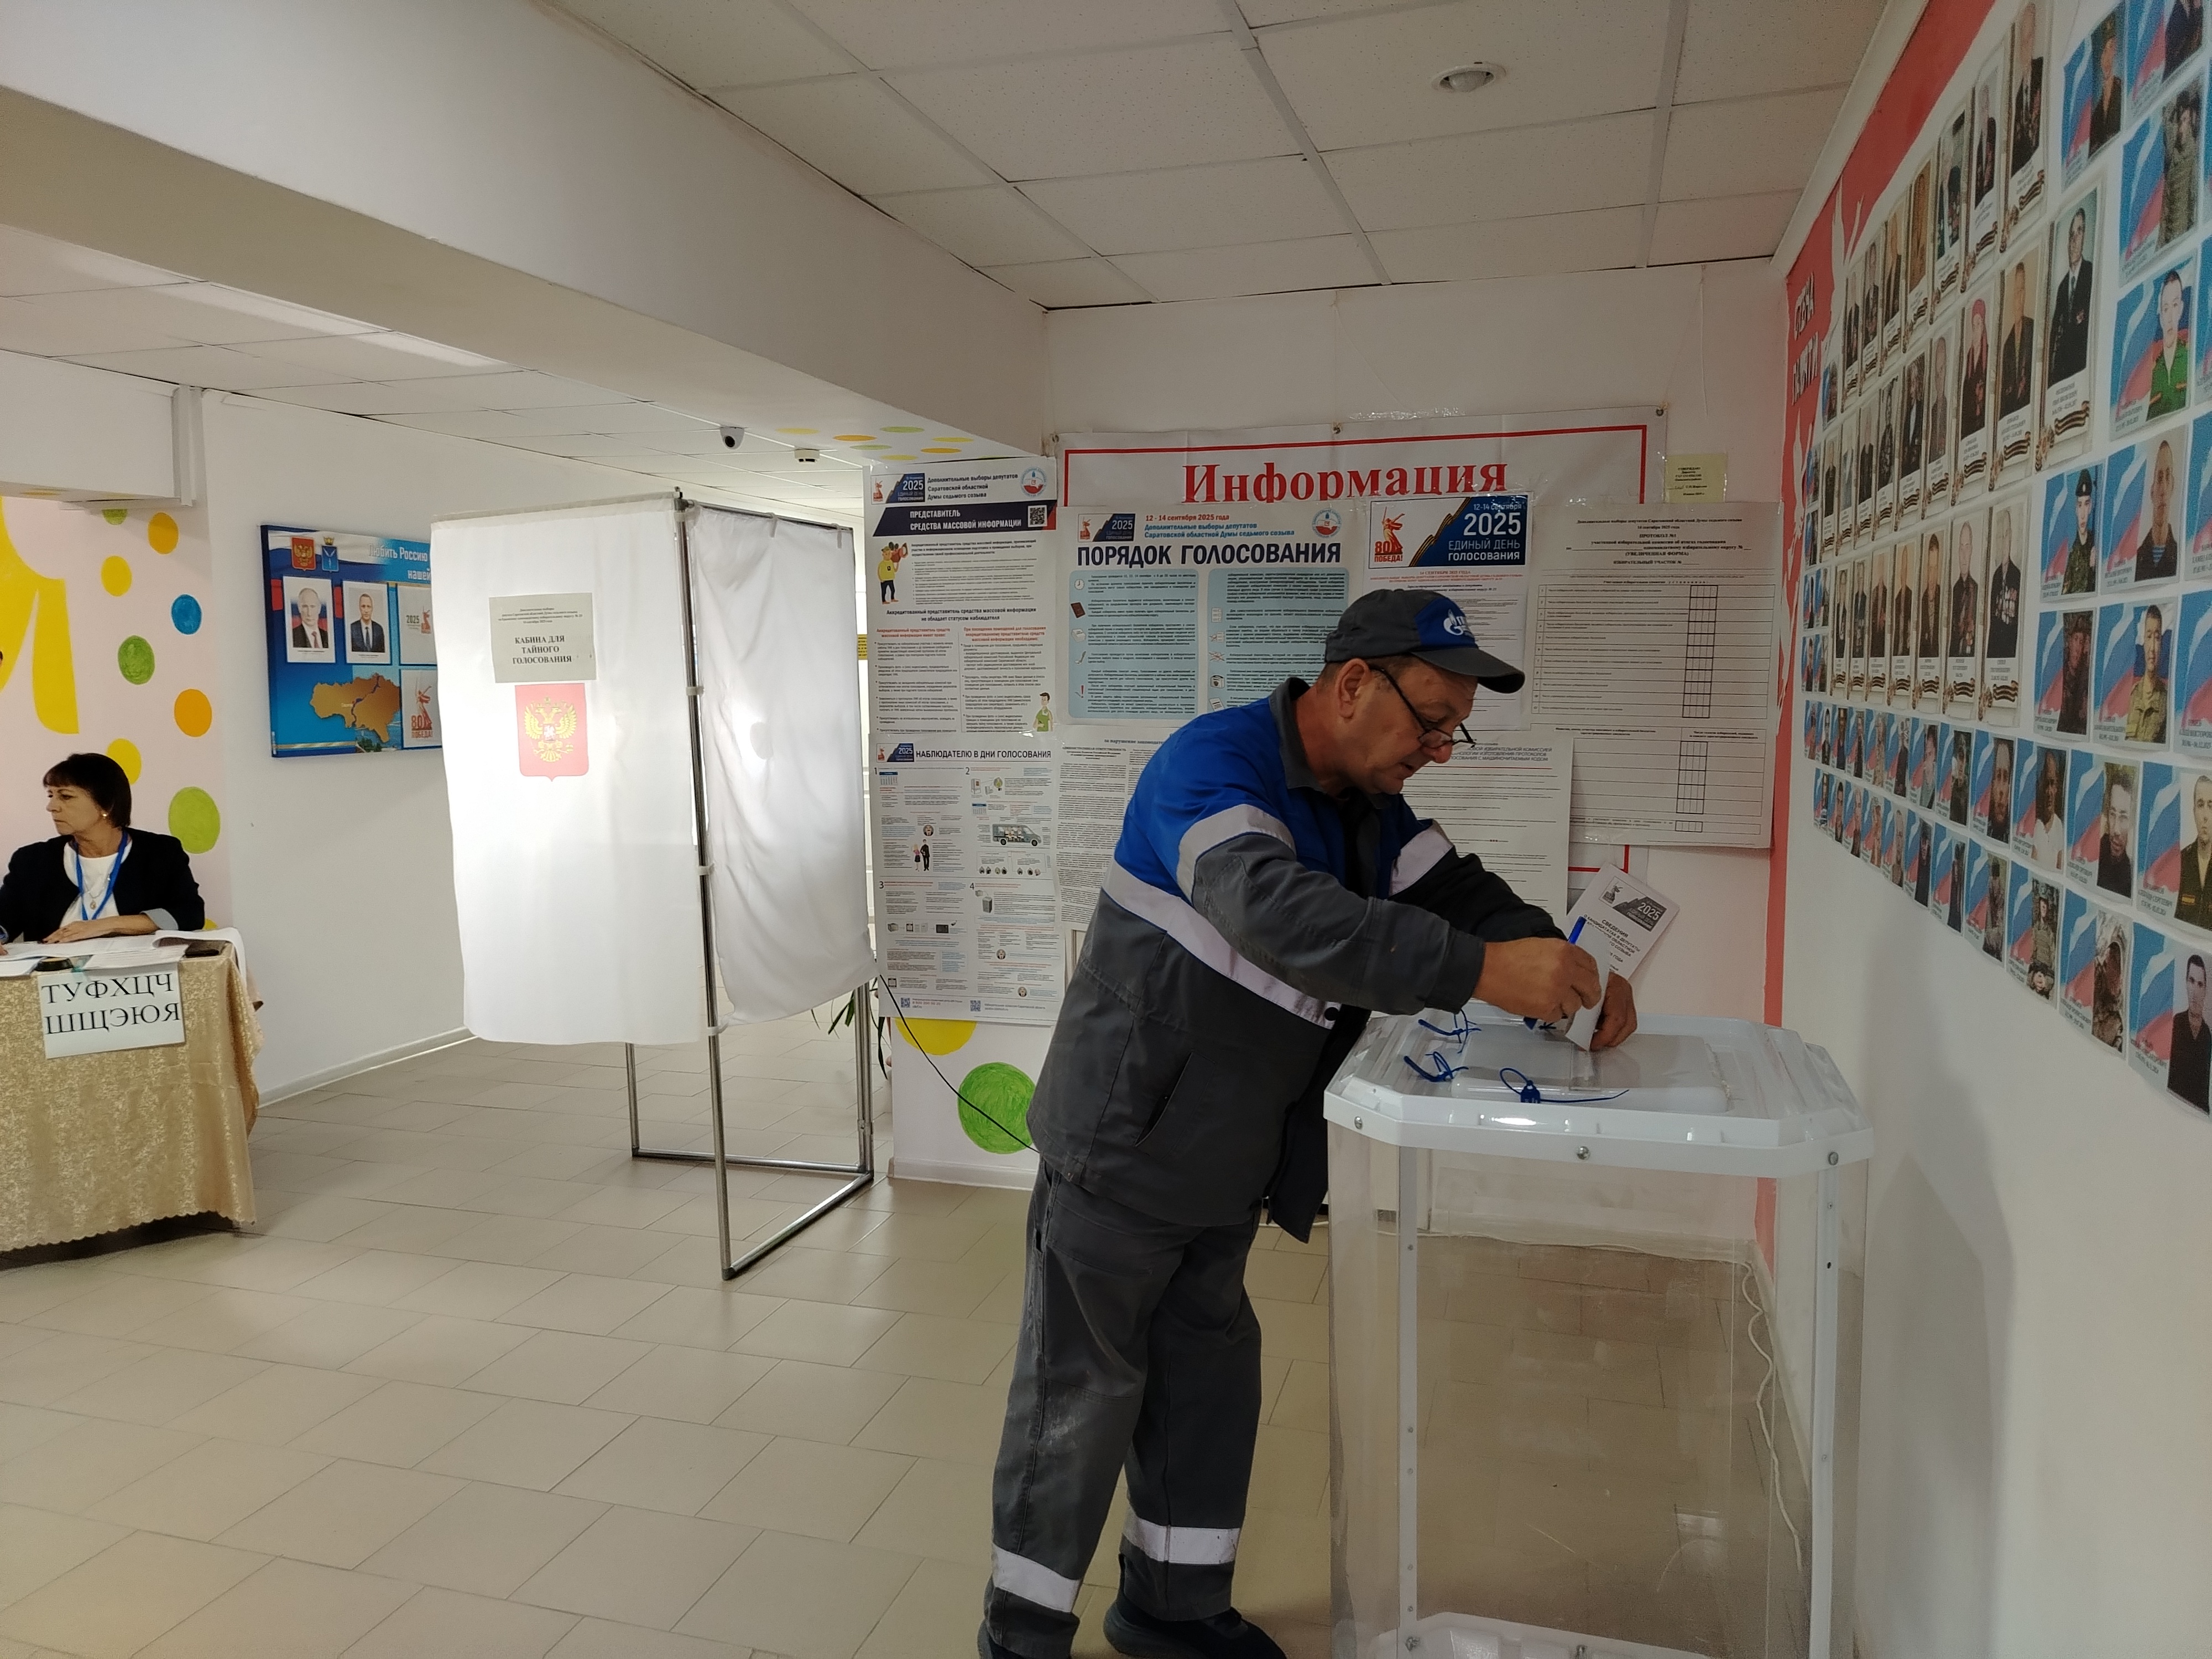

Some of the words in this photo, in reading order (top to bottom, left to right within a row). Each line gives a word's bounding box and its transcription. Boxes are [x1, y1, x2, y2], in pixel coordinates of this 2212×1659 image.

[903, 480, 924, 491] 2025
[1182, 462, 1508, 503] Информация
[910, 510, 961, 519] ПРЕДСТАВИТЕЛЬ
[910, 522, 941, 531] СРЕДСТВА
[943, 520, 976, 530] МАССОВОЙ
[978, 519, 1021, 528] ИНФОРМАЦИИ
[1112, 520, 1133, 530] 2025
[1463, 512, 1521, 535] 2025
[1375, 541, 1390, 553] 80
[1449, 538, 1490, 551] ЕДИНЫЙ
[1493, 539, 1520, 550] ДЕНЬ
[369, 544, 398, 559] Любить
[399, 546, 428, 562] Россию
[1077, 545, 1172, 568] ПОРЯДОК
[1181, 542, 1342, 565] ГОЛОСОВАНИЯ
[1448, 551, 1520, 561] голосования
[408, 568, 431, 581] нашей
[406, 615, 420, 624] 2025
[521, 645, 559, 654] ТАЙНОГО
[513, 655, 572, 664] ГОЛОСОВАНИЯ
[411, 715, 422, 729] 80
[916, 750, 972, 759] НАБЛЮДАТЕЛЮ
[980, 750, 995, 759] ДНИ
[1637, 902, 1661, 921] 2025
[1602, 919, 1629, 938] СВЕДЕНИЯ
[1611, 937, 1635, 953] ОБЛАСТНОЙ
[1620, 937, 1641, 952] ДЕПУТАТЫ
[41, 973, 174, 1003] ТУФХЦЧ
[45, 1003, 180, 1035] ШЩЭЮЯ
